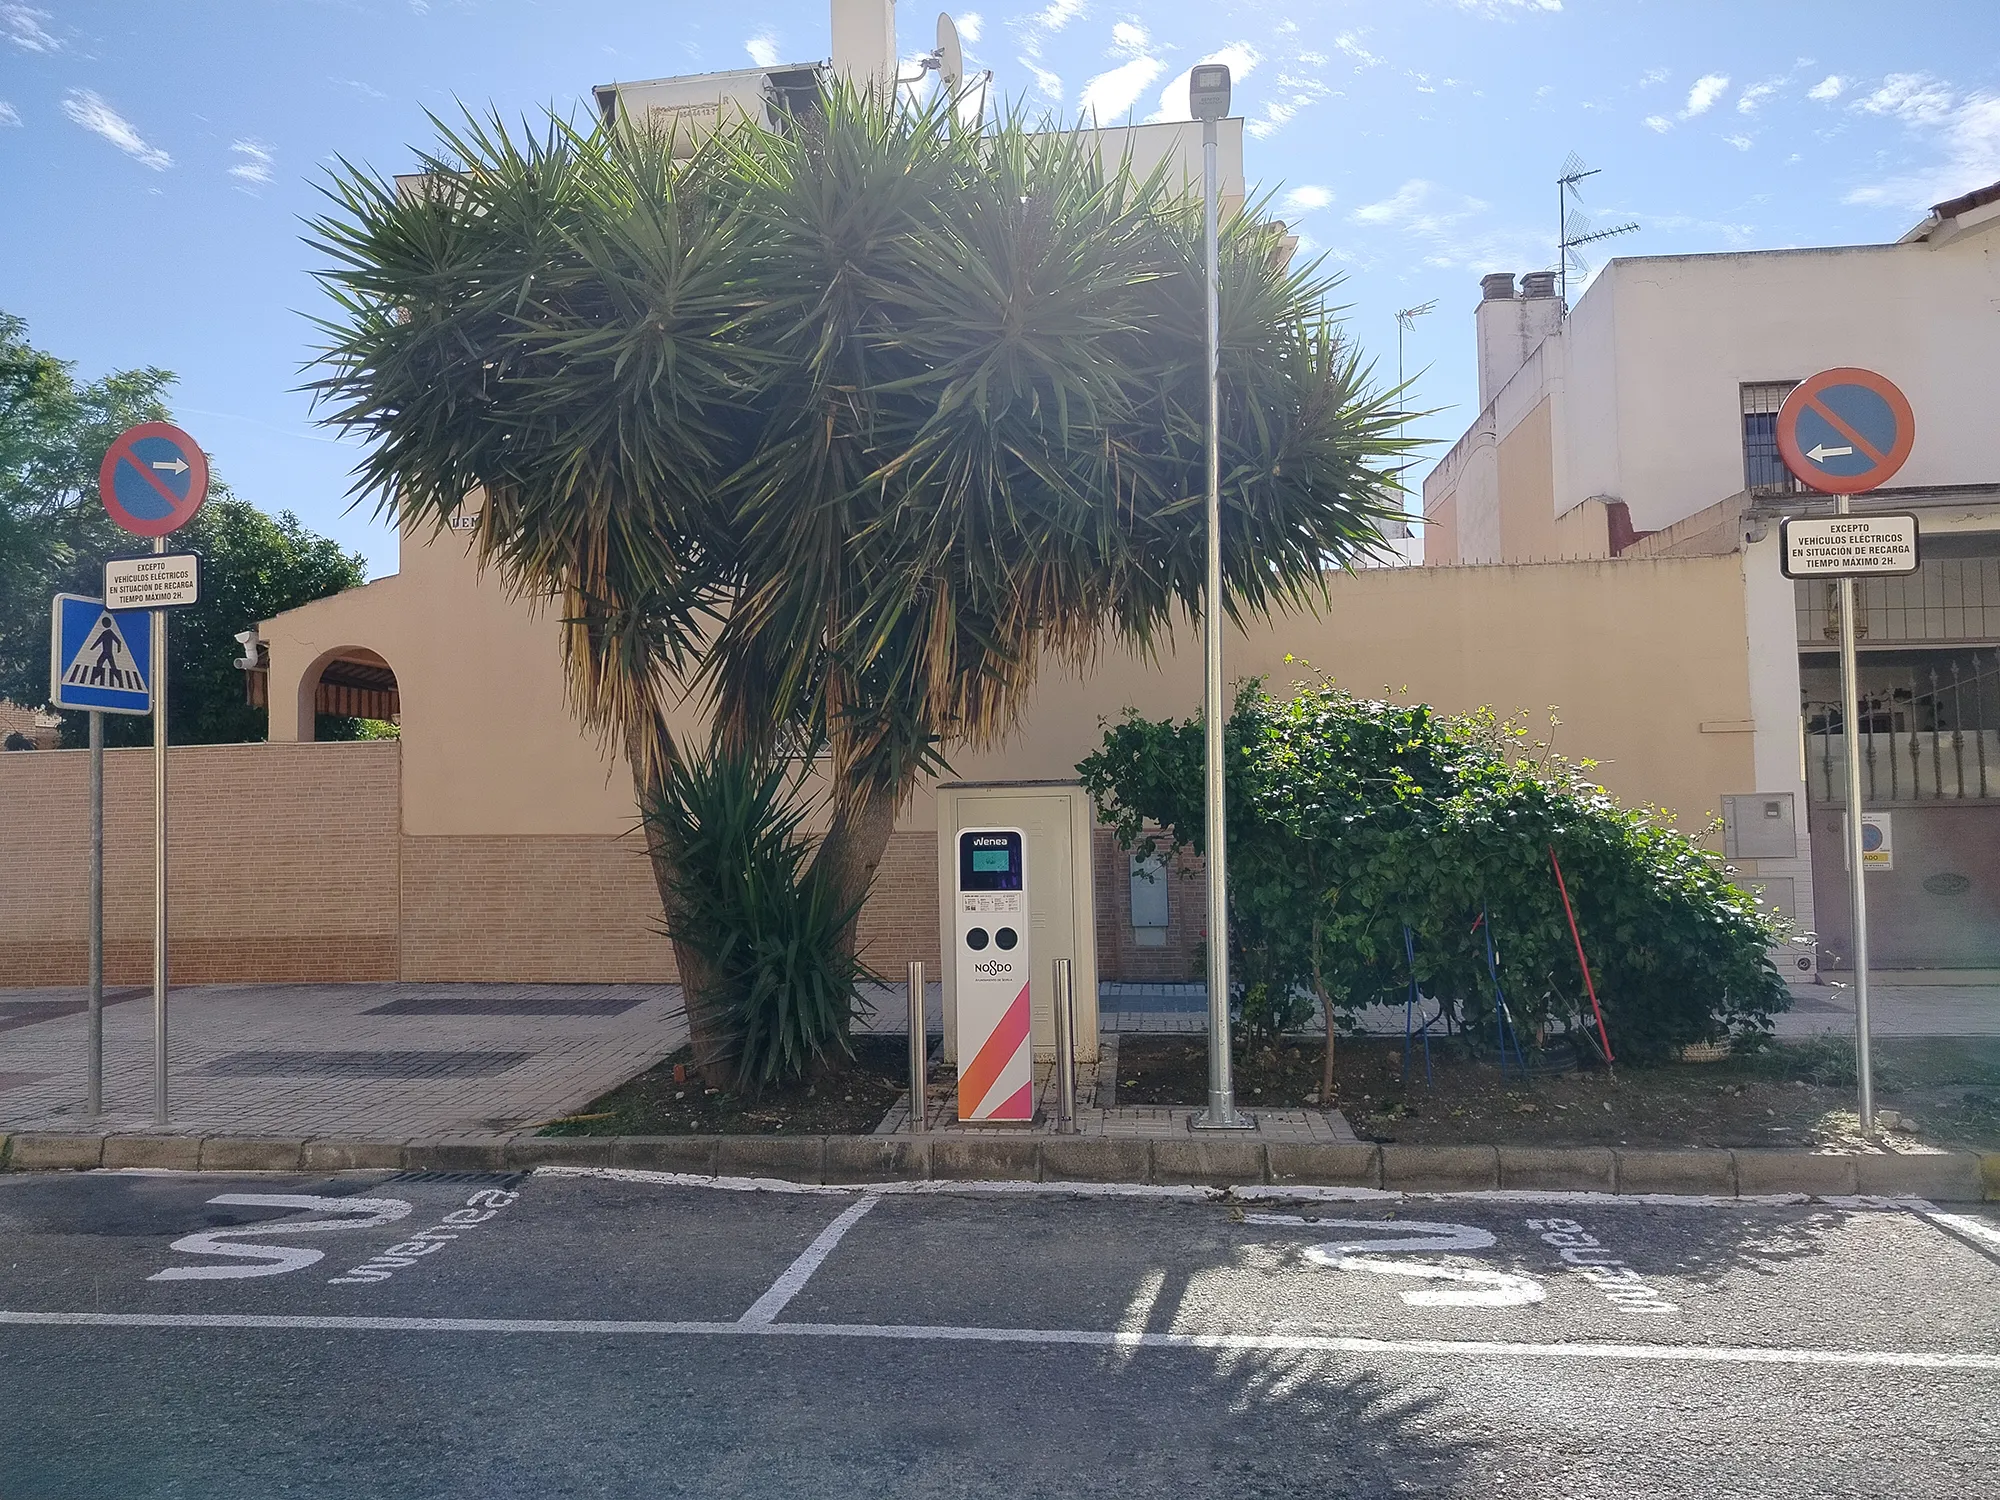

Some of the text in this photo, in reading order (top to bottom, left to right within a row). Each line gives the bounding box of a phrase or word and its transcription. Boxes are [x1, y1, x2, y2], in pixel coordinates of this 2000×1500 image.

[1830, 524, 1869, 533] EXCEPTO
[1798, 533, 1903, 545] VEHÍCULOS ELÉCTRICOS
[1792, 545, 1910, 557] EN SITUACIÓN DE RECARGA
[137, 562, 166, 571] EXCEPTO
[1806, 556, 1896, 568] TIEMPO MÁXIMO 2H.
[114, 571, 189, 583] VEHÍCULOS ELÉCTRICOS
[110, 581, 194, 594] EN SITUACIÓN DE RECARGA
[119, 594, 144, 603] TIEMPO
[145, 592, 171, 601] MÁXIMO
